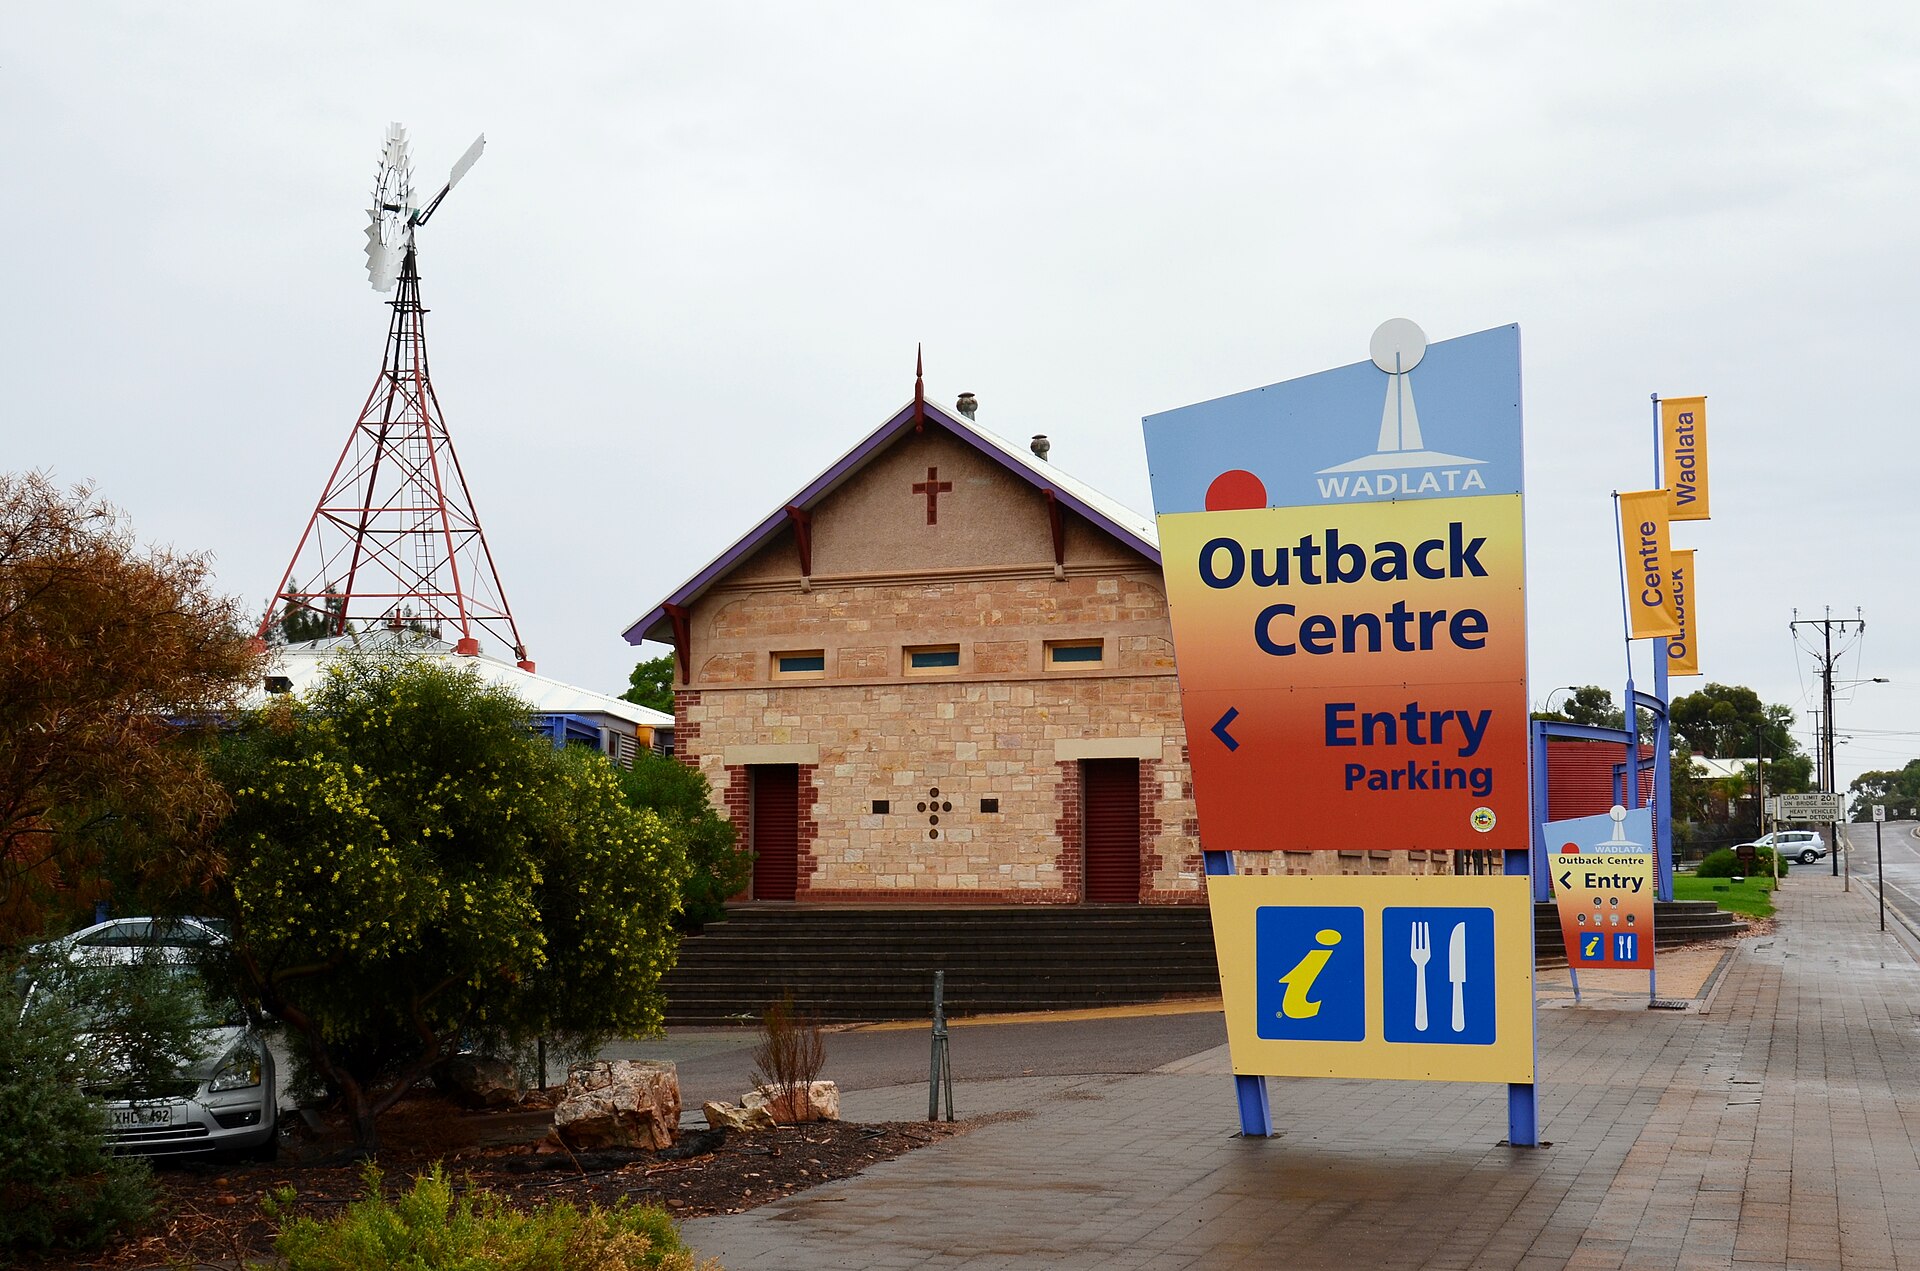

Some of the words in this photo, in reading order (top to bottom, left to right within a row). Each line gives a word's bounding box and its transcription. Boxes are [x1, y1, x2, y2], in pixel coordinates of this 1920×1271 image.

[1317, 469, 1487, 498] WADLATA
[1675, 412, 1697, 507] Wadlata
[1199, 521, 1489, 590] Outback
[1639, 521, 1664, 607] Centre
[1254, 600, 1489, 656] Centre
[1668, 568, 1687, 659] Ouack
[1325, 701, 1492, 757] Entry
[1345, 761, 1493, 797] Parking
[1558, 856, 1603, 865] Outback
[1607, 856, 1645, 865] Centre
[1585, 873, 1644, 893] Entry
